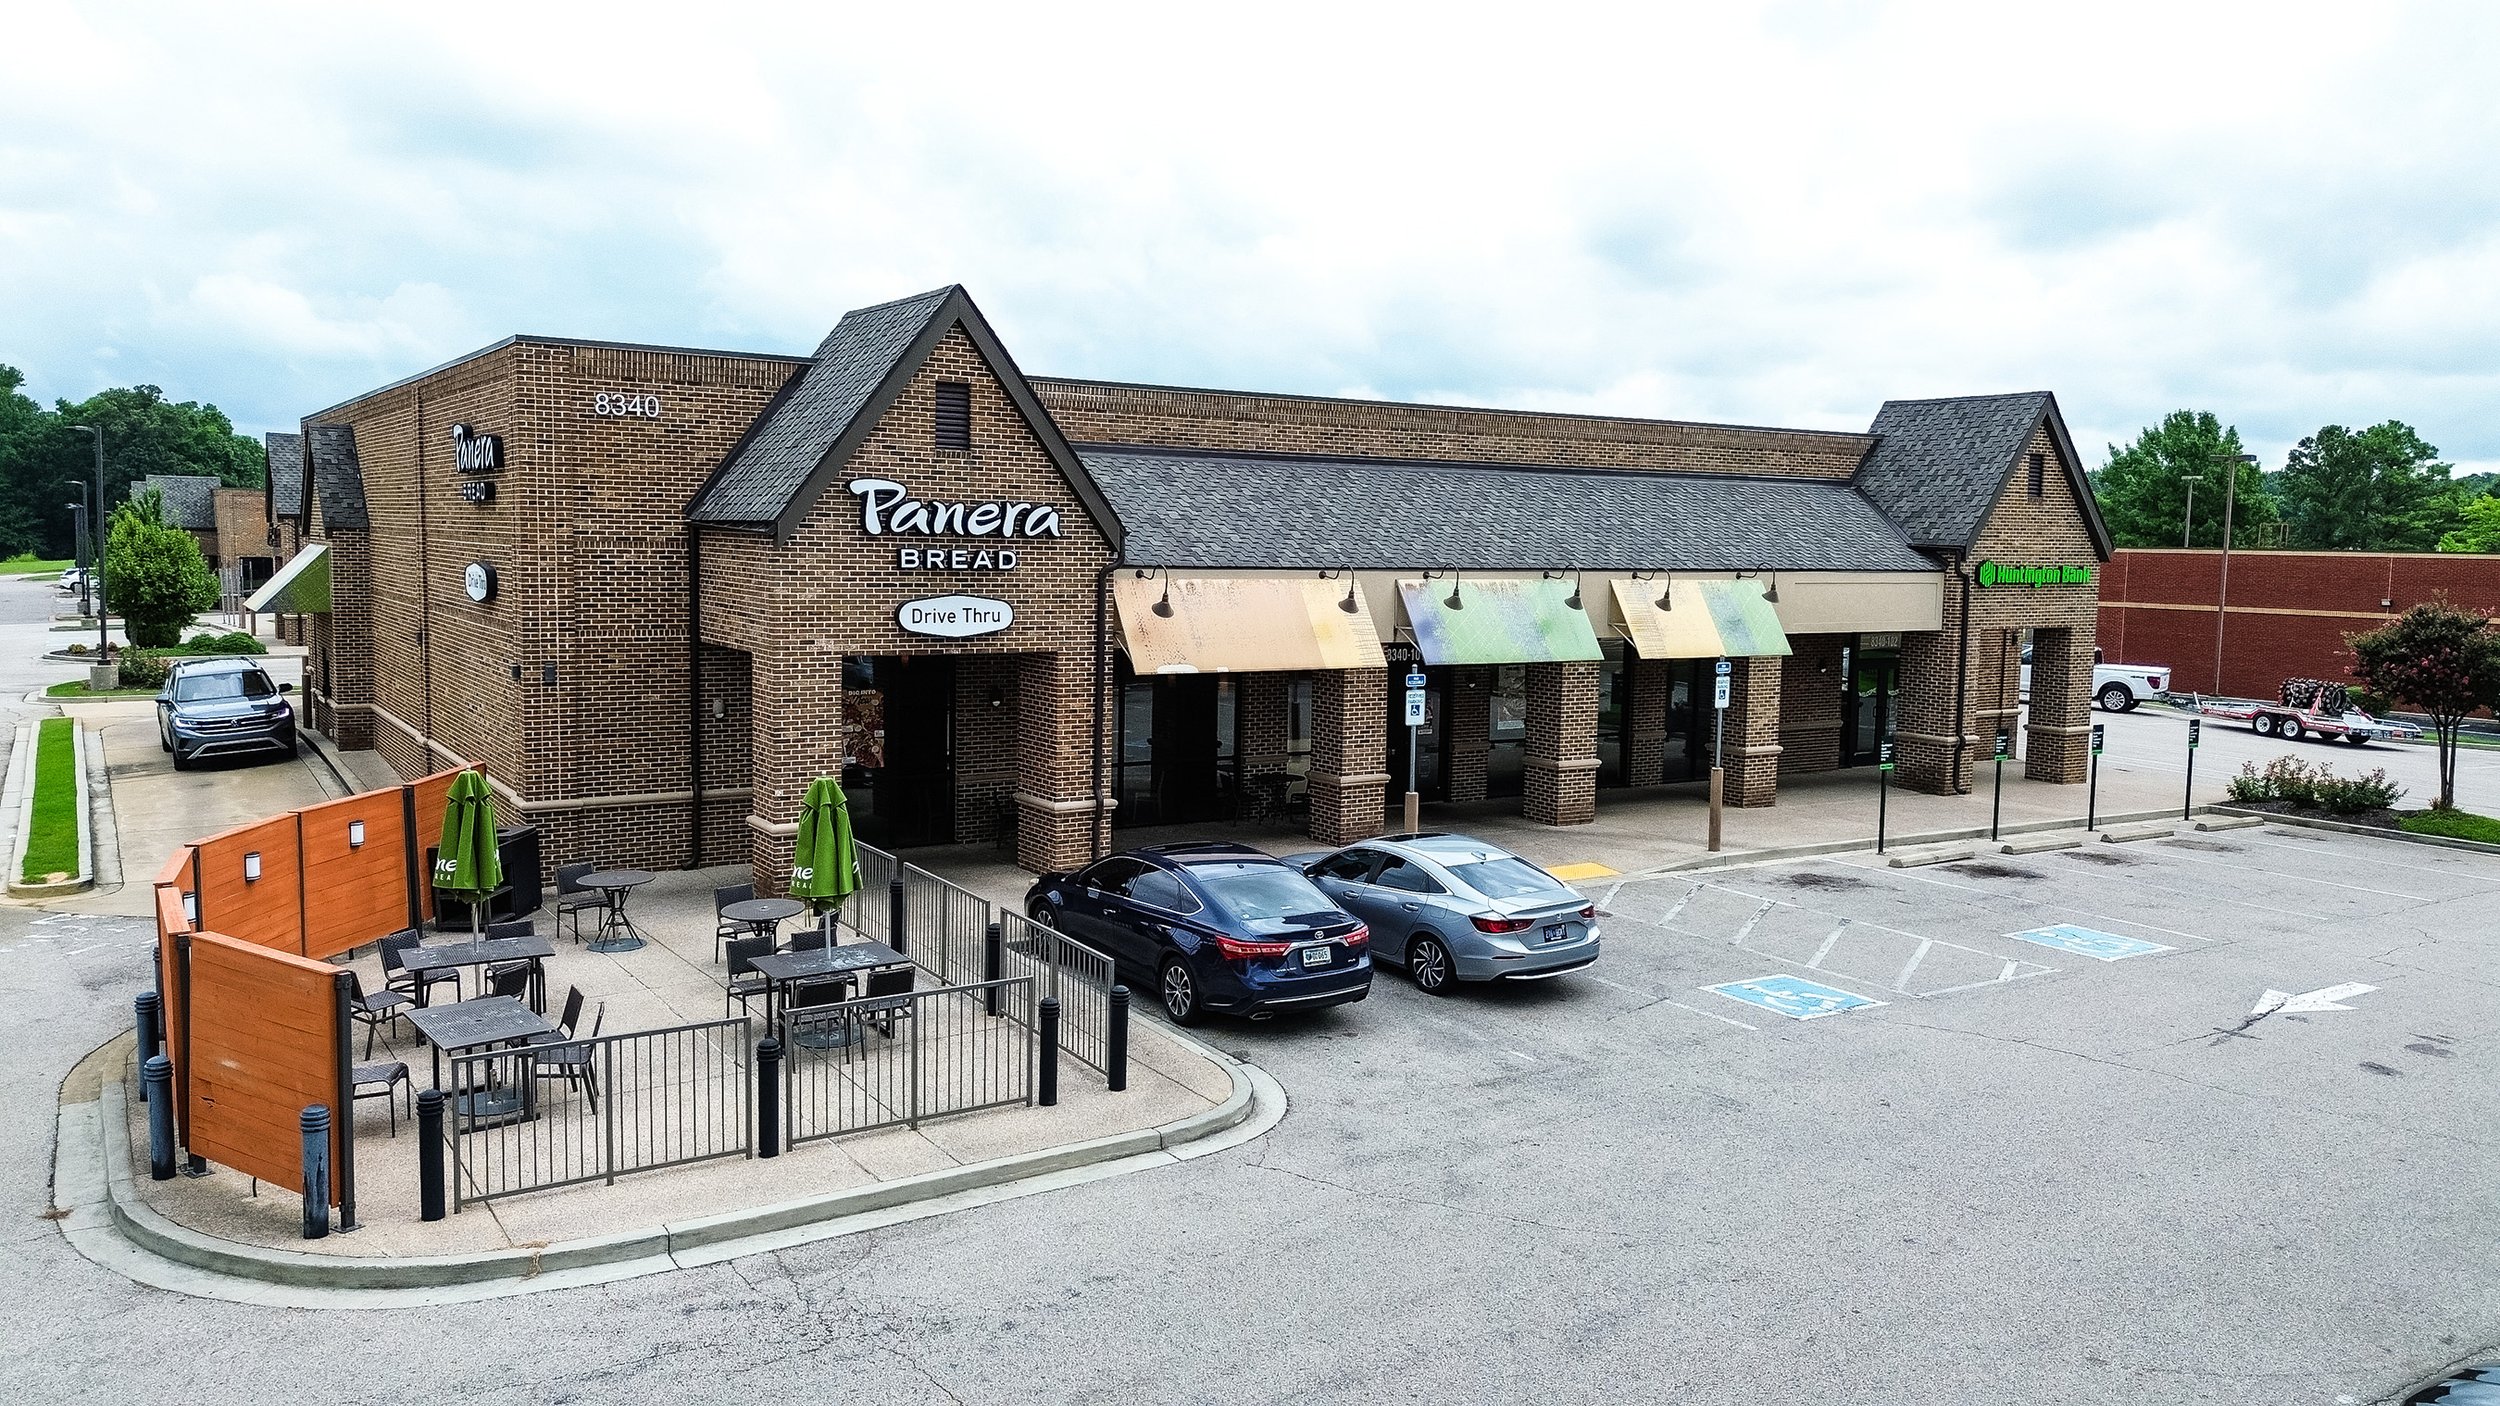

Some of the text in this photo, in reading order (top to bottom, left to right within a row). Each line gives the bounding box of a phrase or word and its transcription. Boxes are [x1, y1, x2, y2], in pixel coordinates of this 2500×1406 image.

[594, 392, 660, 418] 8340
[453, 424, 494, 473] Panera
[849, 478, 1061, 537] Panera
[900, 549, 1017, 570] BREAD
[1997, 564, 2091, 588] Huntington Bank
[911, 608, 1001, 625] Drive Thru
